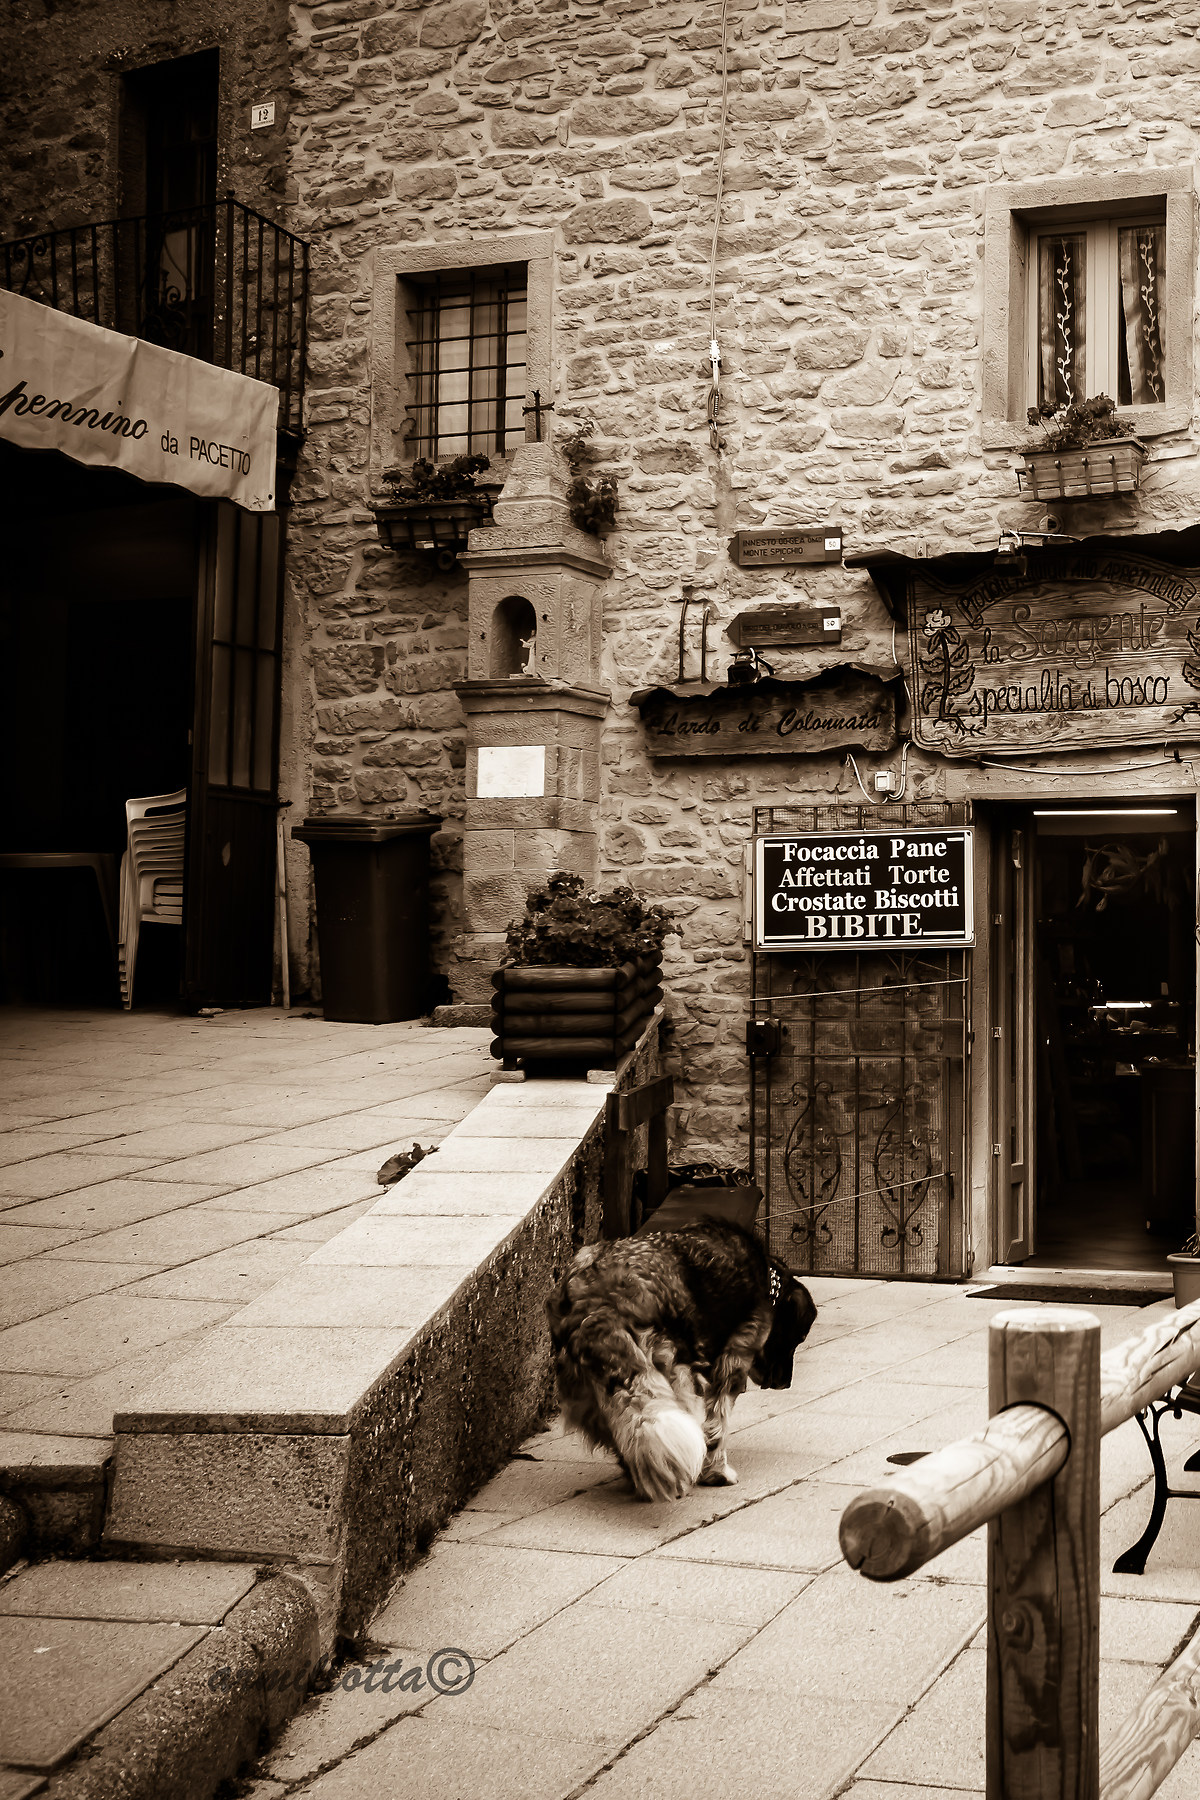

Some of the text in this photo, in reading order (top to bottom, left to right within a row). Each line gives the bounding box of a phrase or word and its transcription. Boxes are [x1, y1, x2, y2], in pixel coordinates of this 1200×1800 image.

[160, 429, 179, 456] da
[189, 436, 252, 476] PACETTO
[743, 538, 777, 547] INNESTO
[980, 626, 1003, 664] la
[1082, 680, 1099, 709] di
[1105, 666, 1171, 708] bosco
[657, 707, 881, 738] Lardo di Colonnata
[782, 838, 948, 863] Focaccia Pane
[778, 865, 951, 888] Affettati Torte
[771, 886, 960, 912] Crostate Biscotti
[804, 912, 923, 940] BIBITE
